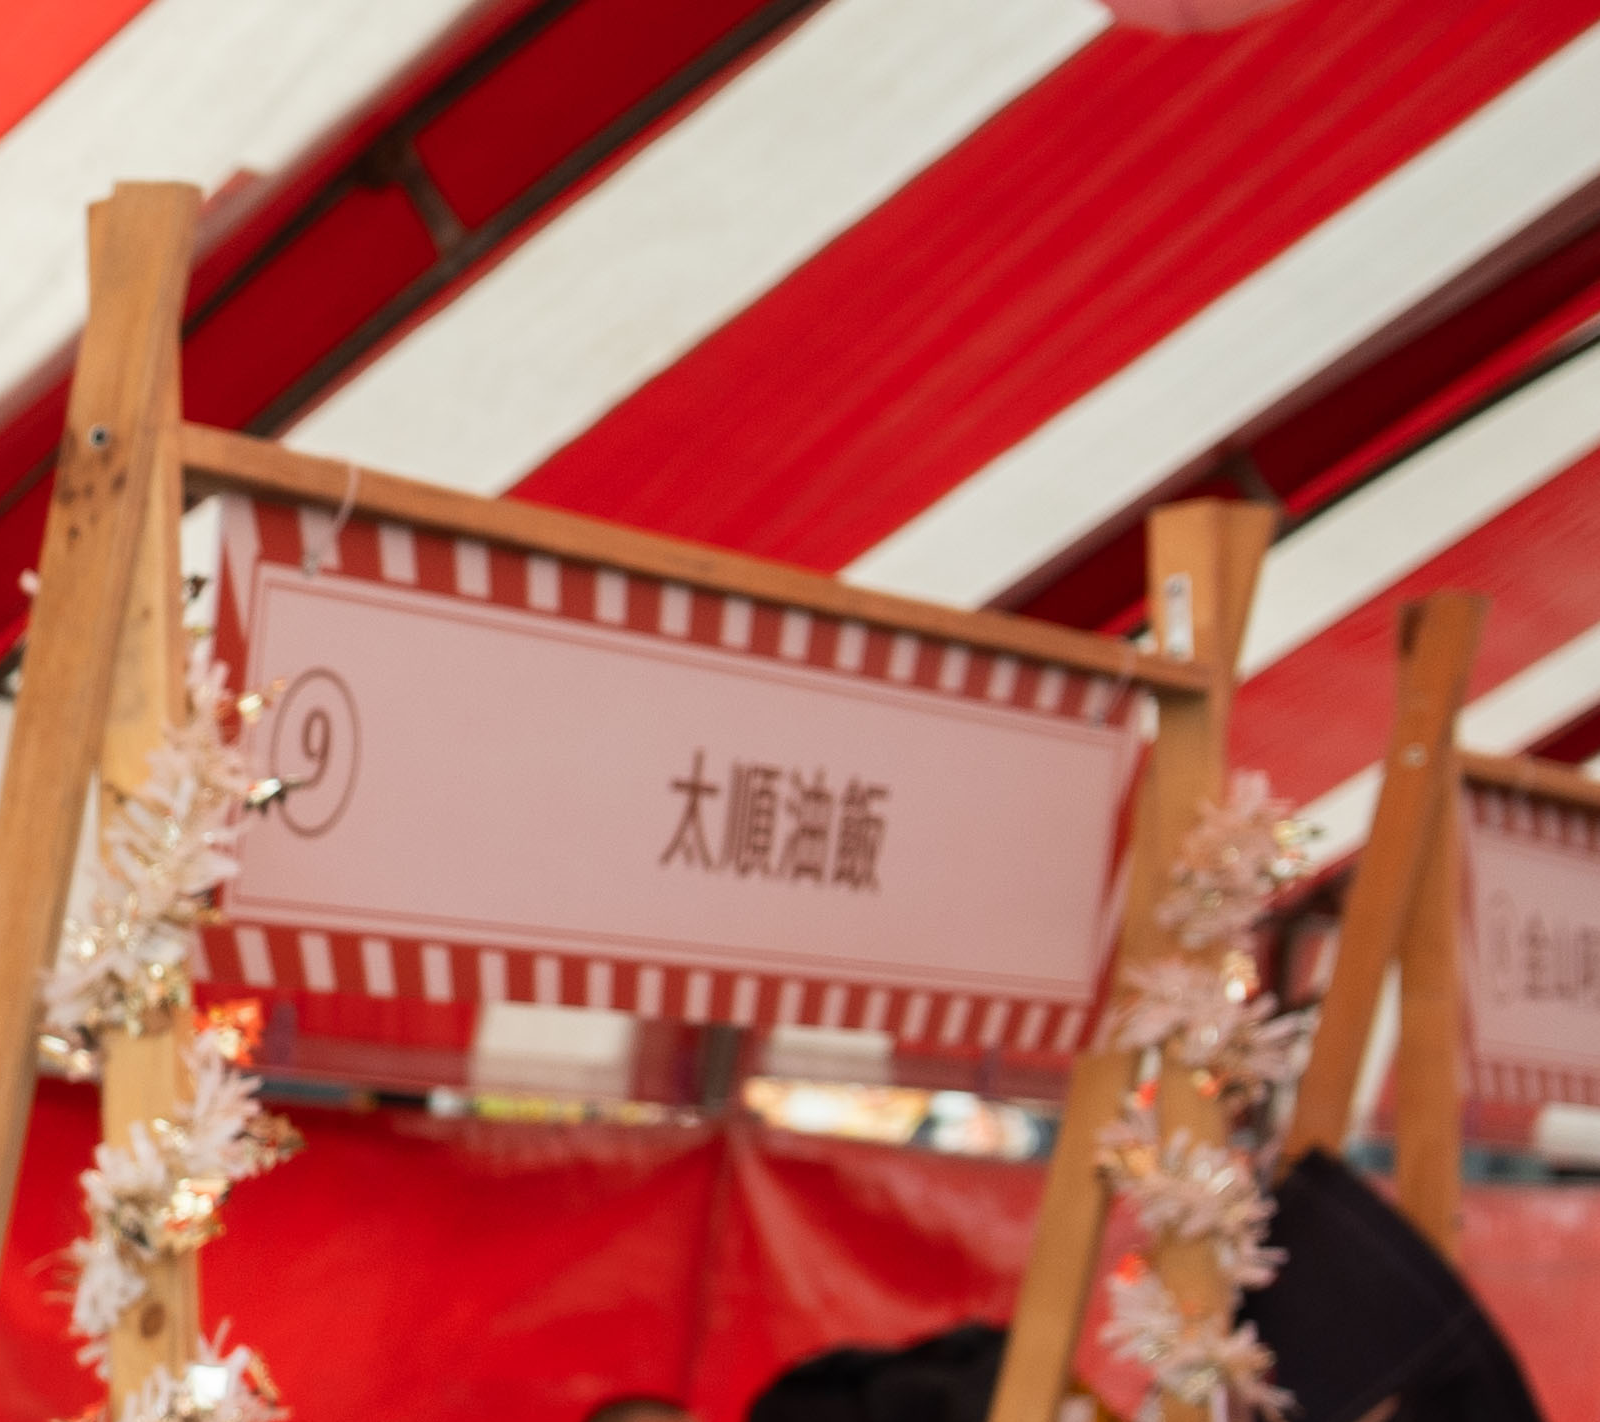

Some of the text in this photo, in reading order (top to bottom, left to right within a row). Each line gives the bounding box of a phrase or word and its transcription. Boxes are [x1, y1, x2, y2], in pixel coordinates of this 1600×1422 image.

[287, 706, 331, 787] 9
[659, 746, 891, 892] 太順油飯
